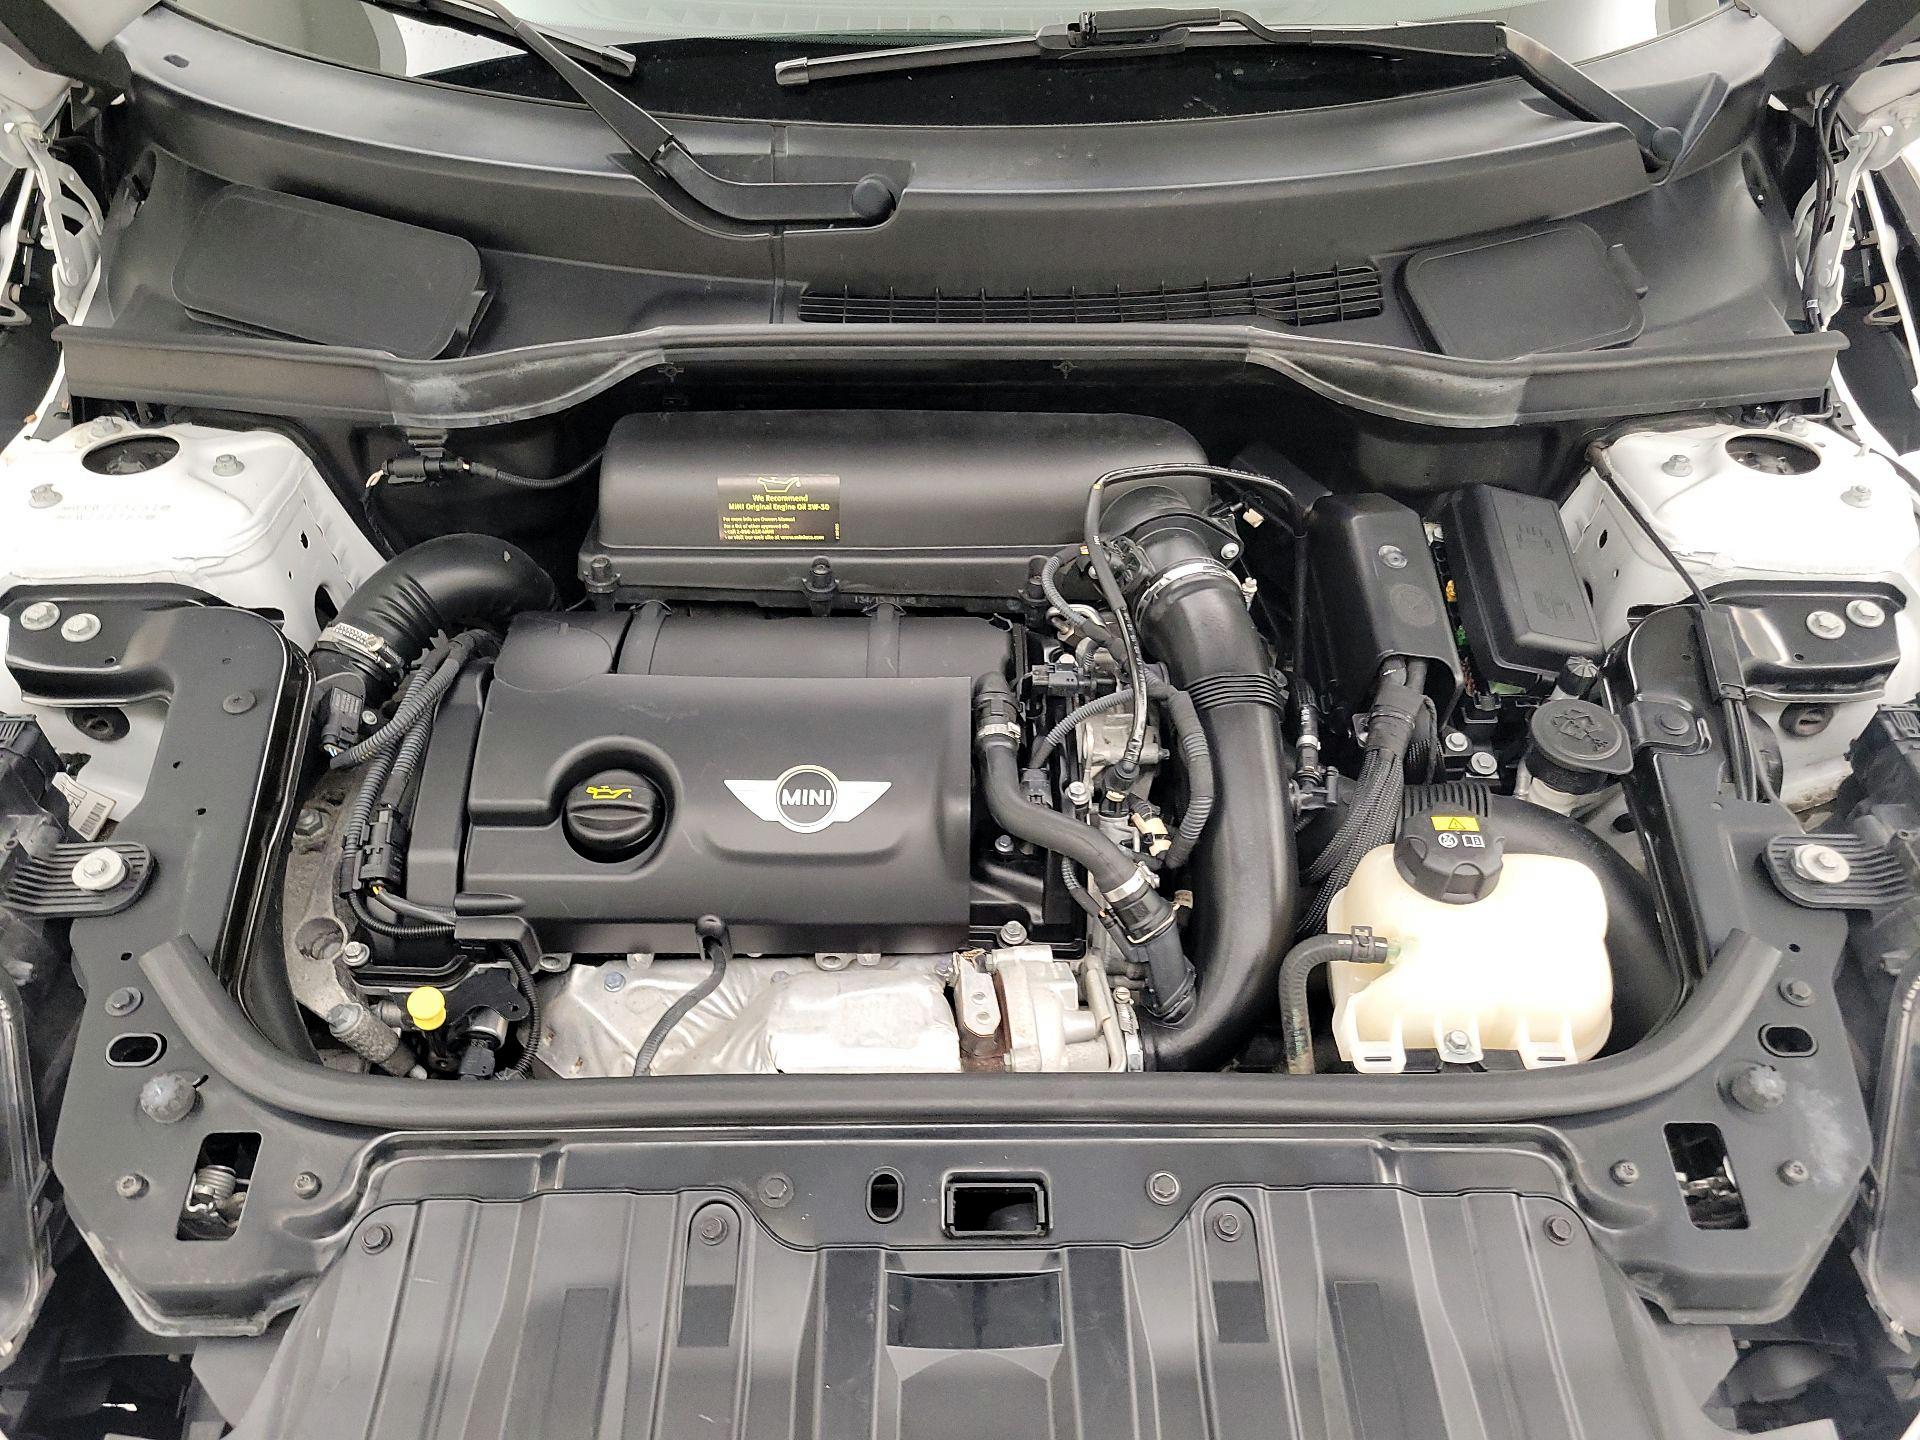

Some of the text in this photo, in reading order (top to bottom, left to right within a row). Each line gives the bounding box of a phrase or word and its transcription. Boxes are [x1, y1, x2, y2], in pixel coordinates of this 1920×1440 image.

[752, 494, 809, 502] We Recommend
[728, 503, 830, 512] MINI Original Engine Oil 5W-30
[781, 788, 832, 807] MINI
